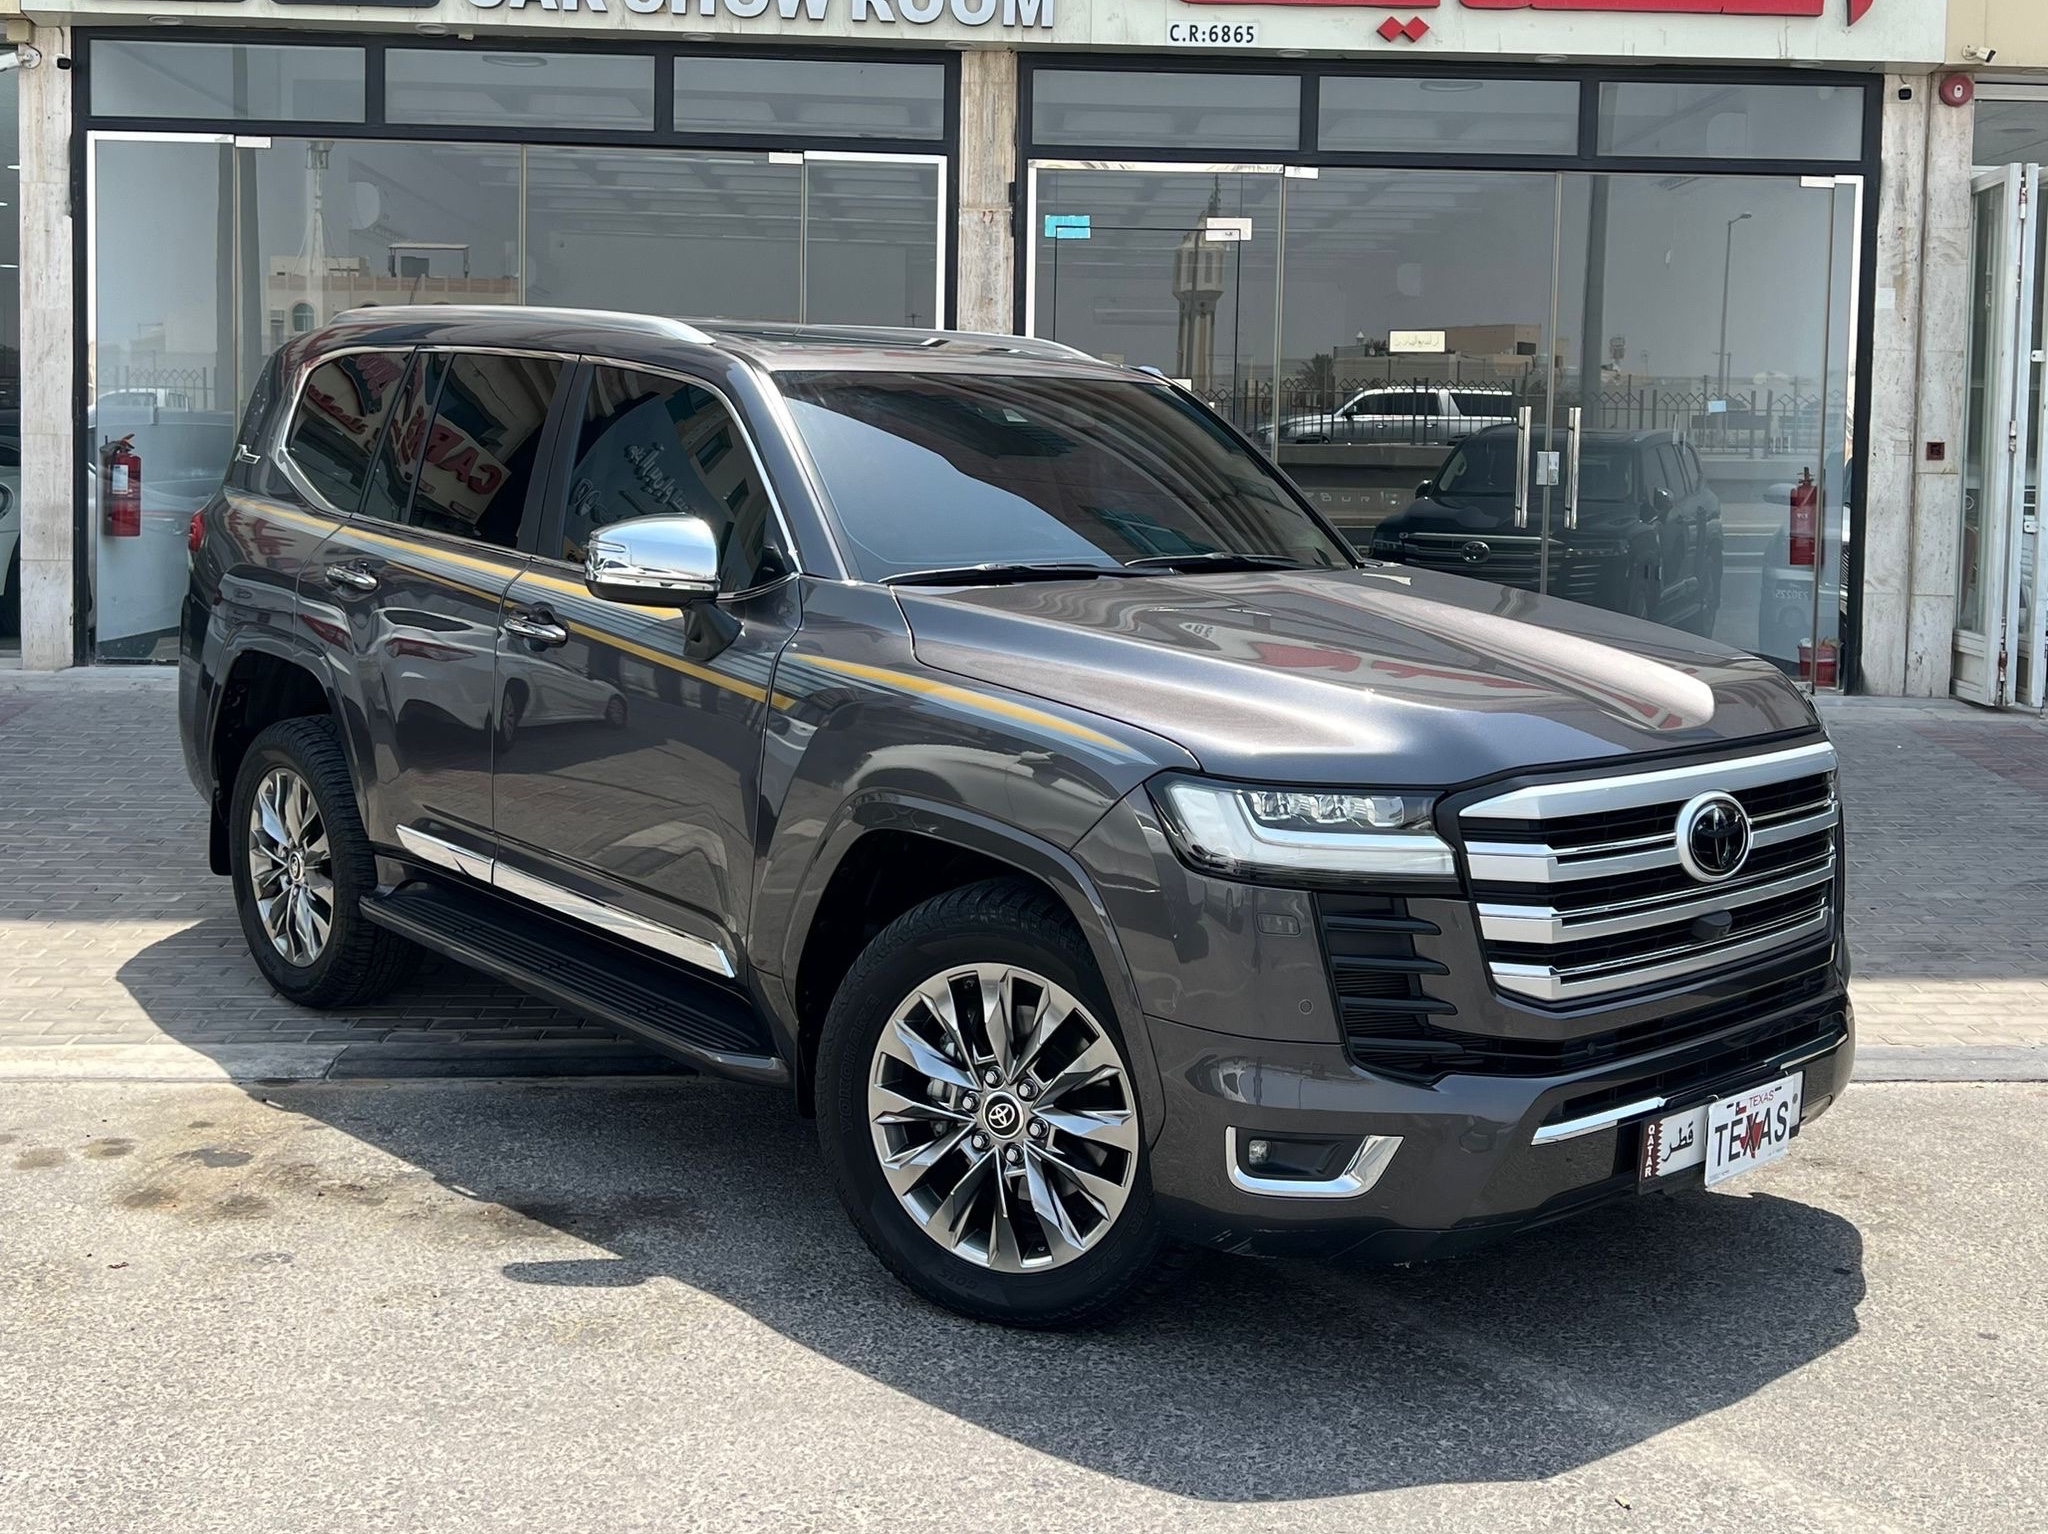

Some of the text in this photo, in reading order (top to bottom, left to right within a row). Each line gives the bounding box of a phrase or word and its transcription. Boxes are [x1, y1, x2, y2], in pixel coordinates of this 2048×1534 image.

[1169, 24, 1255, 43] C.R:6865
[1749, 1089, 1775, 1108] TEXAS
[1644, 1124, 1656, 1178] QATAR
[1661, 1120, 1694, 1163] قطر
[1714, 1100, 1789, 1167] TEXAS
